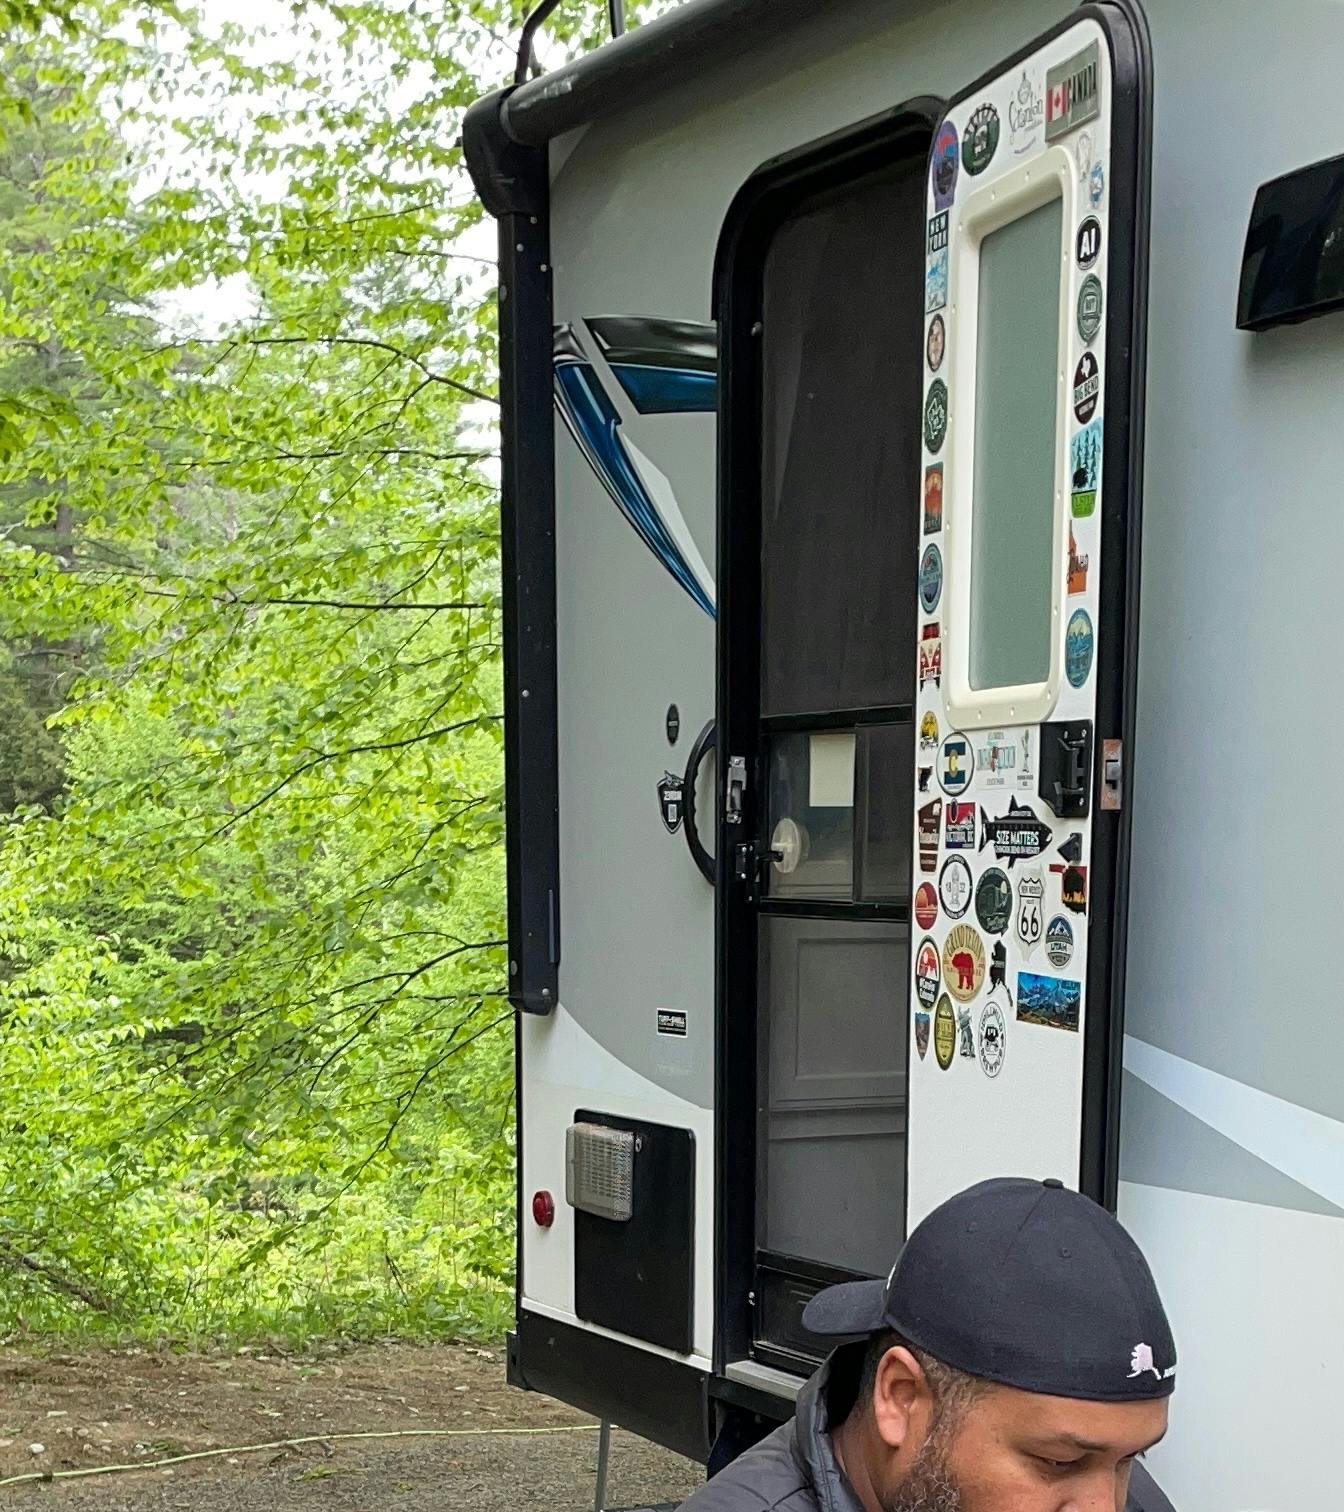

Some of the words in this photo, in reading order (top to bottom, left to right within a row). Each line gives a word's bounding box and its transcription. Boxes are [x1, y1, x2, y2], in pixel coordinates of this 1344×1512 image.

[996, 830, 1009, 845] SIZE
[1010, 831, 1039, 846] MATTERS
[1021, 905, 1038, 936] 66
